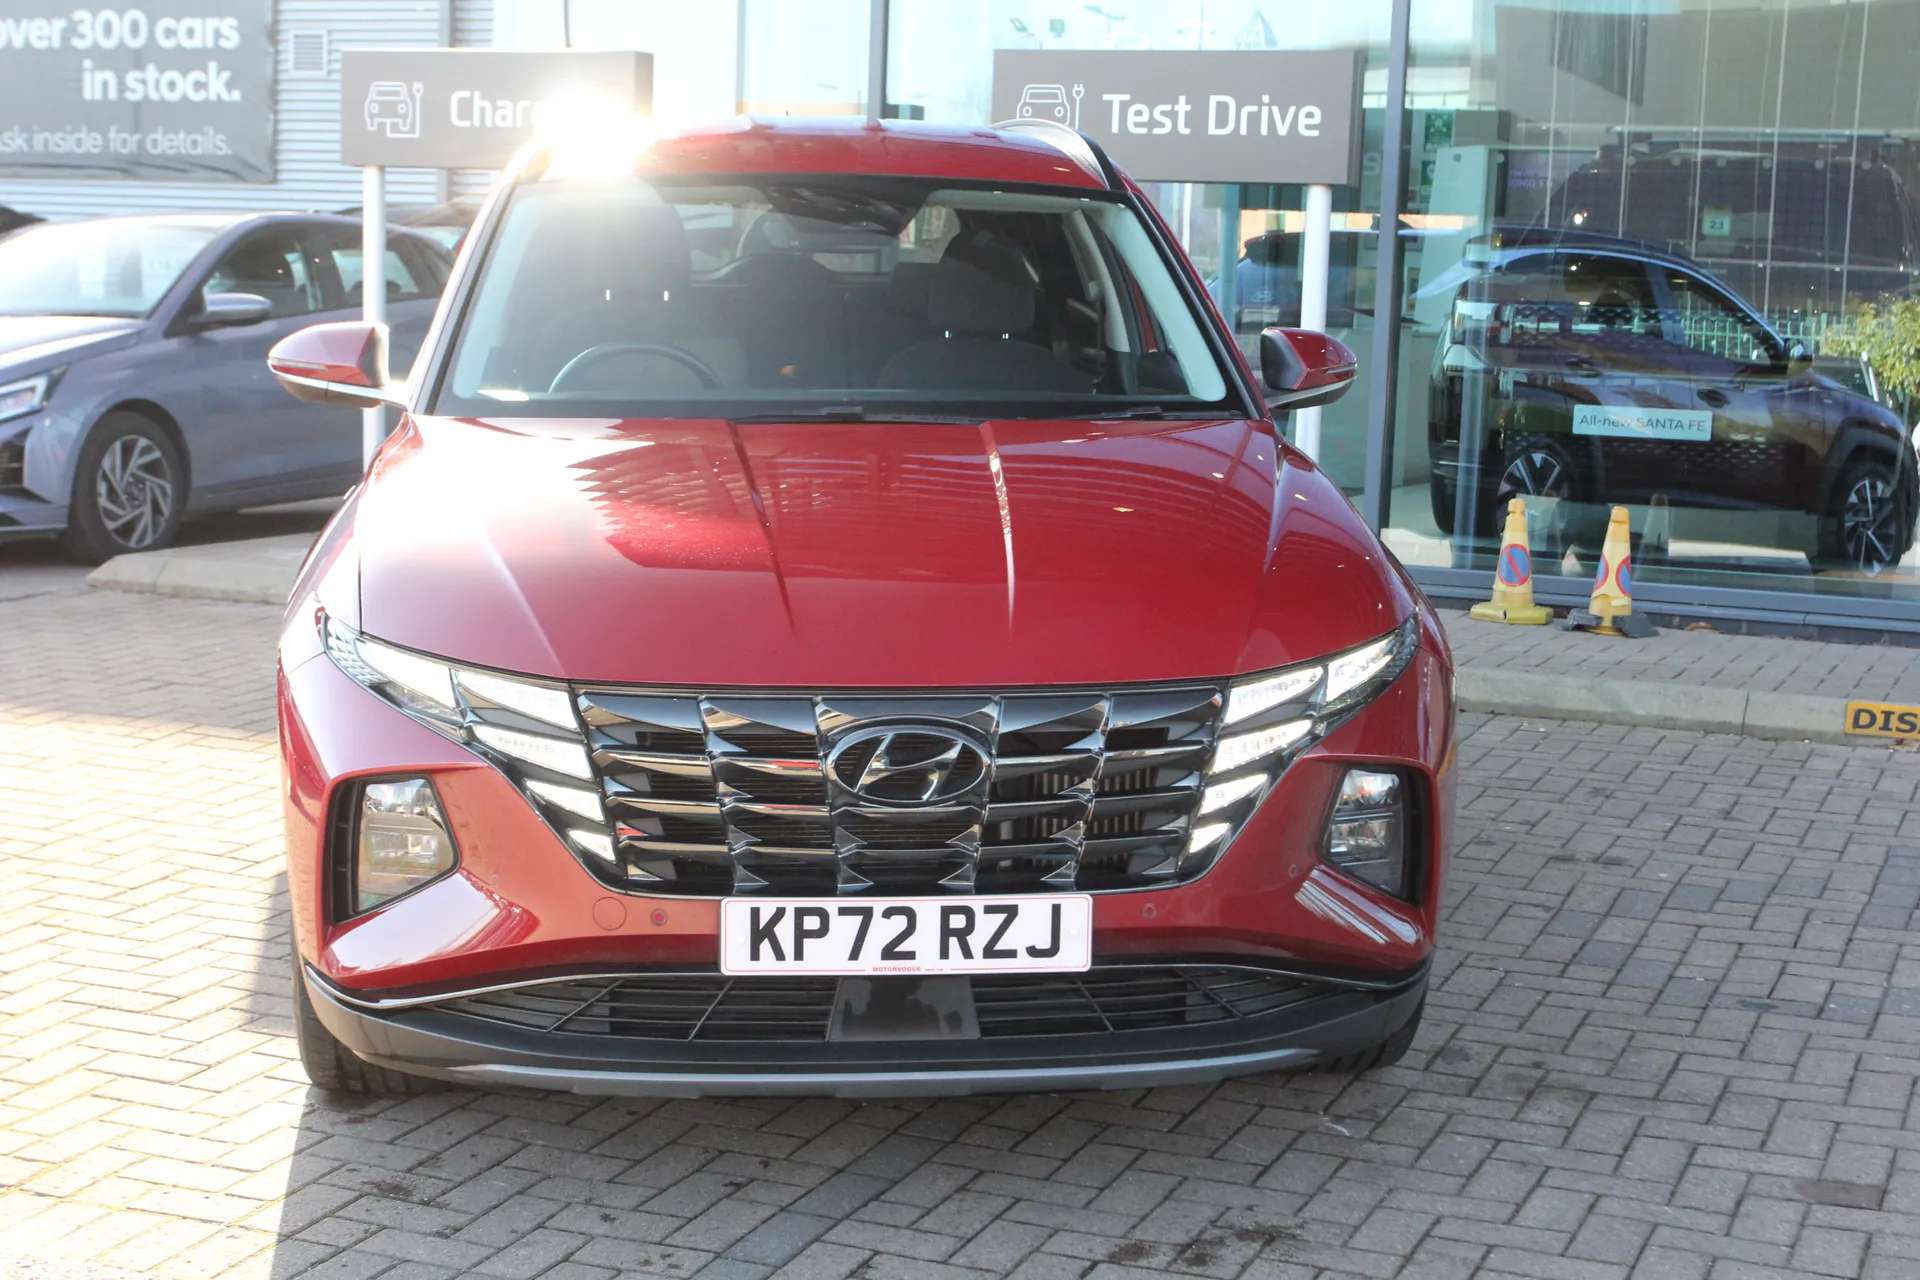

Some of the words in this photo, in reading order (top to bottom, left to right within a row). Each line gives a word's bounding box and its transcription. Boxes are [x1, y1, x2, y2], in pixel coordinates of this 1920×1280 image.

[69, 9, 149, 50] 300
[154, 15, 241, 49] cars
[81, 58, 119, 101] in
[124, 60, 242, 102] stock.
[1101, 93, 1192, 135] Test
[1207, 94, 1322, 137] Drive
[32, 125, 103, 153] inside
[109, 125, 141, 153] for
[146, 126, 233, 155] details.
[1635, 417, 1684, 431] SANTA
[1687, 419, 1706, 432] FE
[749, 905, 918, 962] KP72
[939, 903, 1062, 960] RZJ
